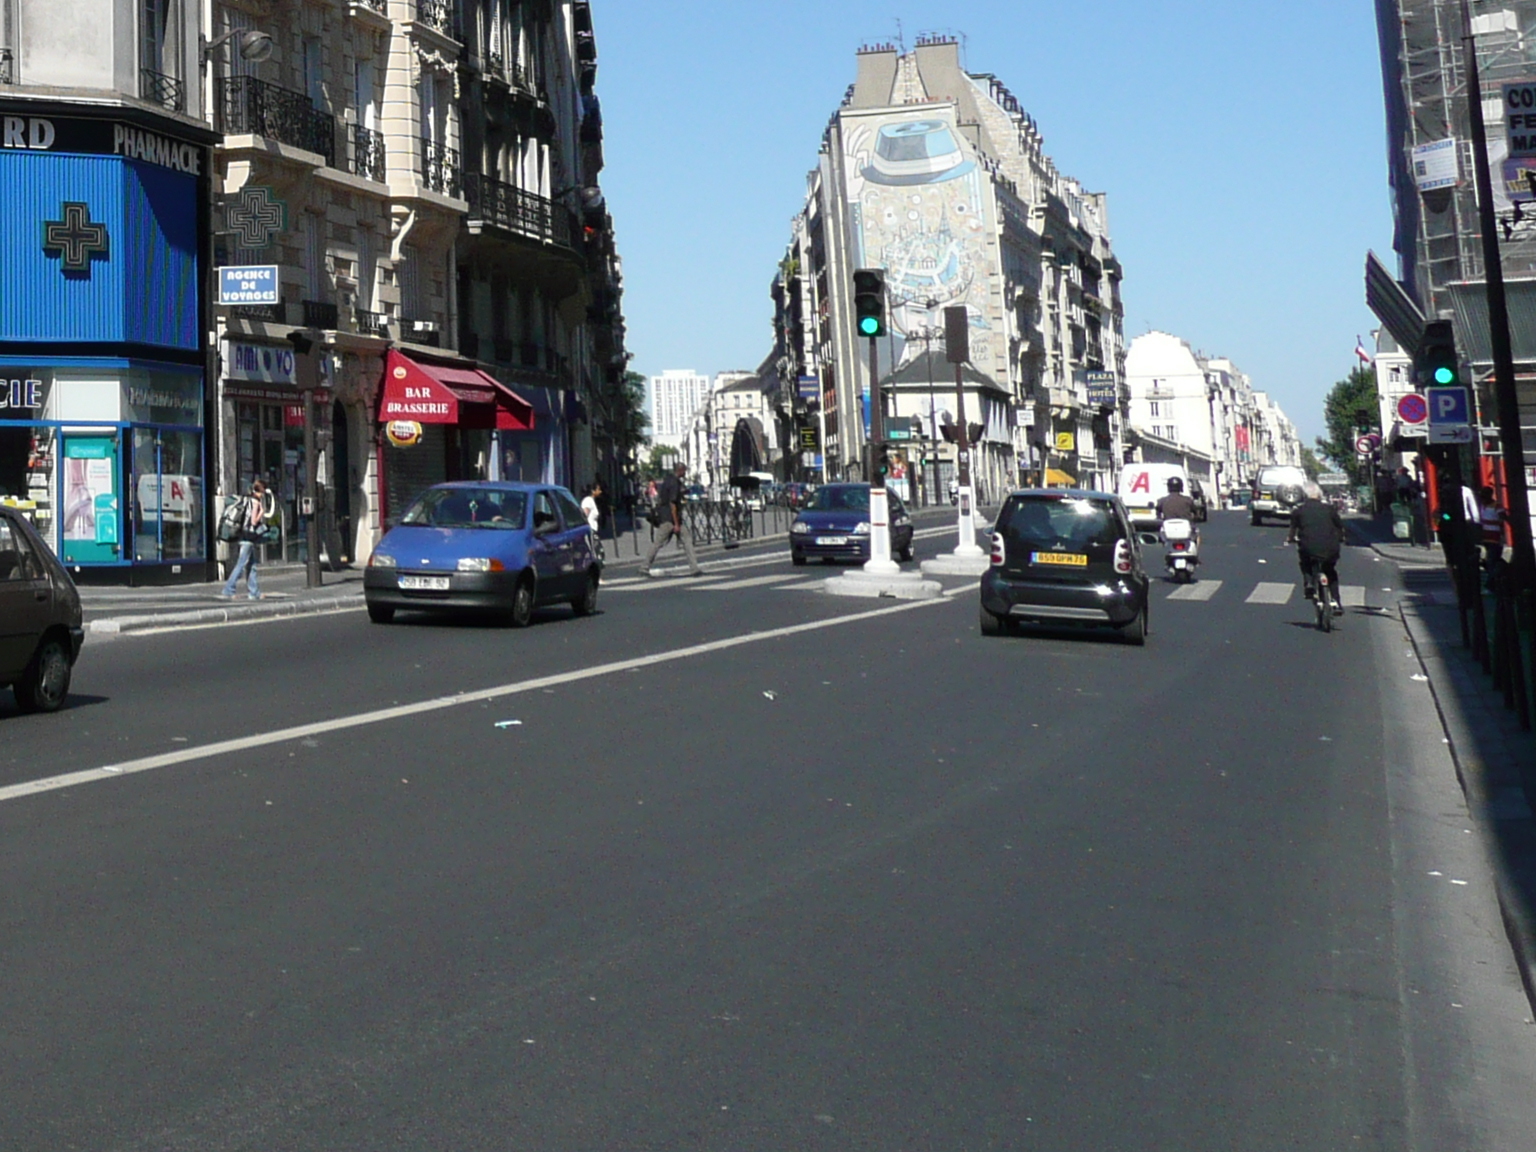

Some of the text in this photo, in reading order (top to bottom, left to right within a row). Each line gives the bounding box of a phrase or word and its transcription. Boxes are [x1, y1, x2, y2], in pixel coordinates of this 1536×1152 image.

[1507, 88, 1536, 109] CO
[113, 123, 201, 177] PHARMACIE
[227, 270, 271, 280] AGENCE
[241, 281, 256, 290] DE
[222, 290, 275, 301] VOYAGES
[405, 387, 431, 399] BAR
[387, 402, 449, 415] BRASSERIE
[1438, 395, 1457, 418] P
